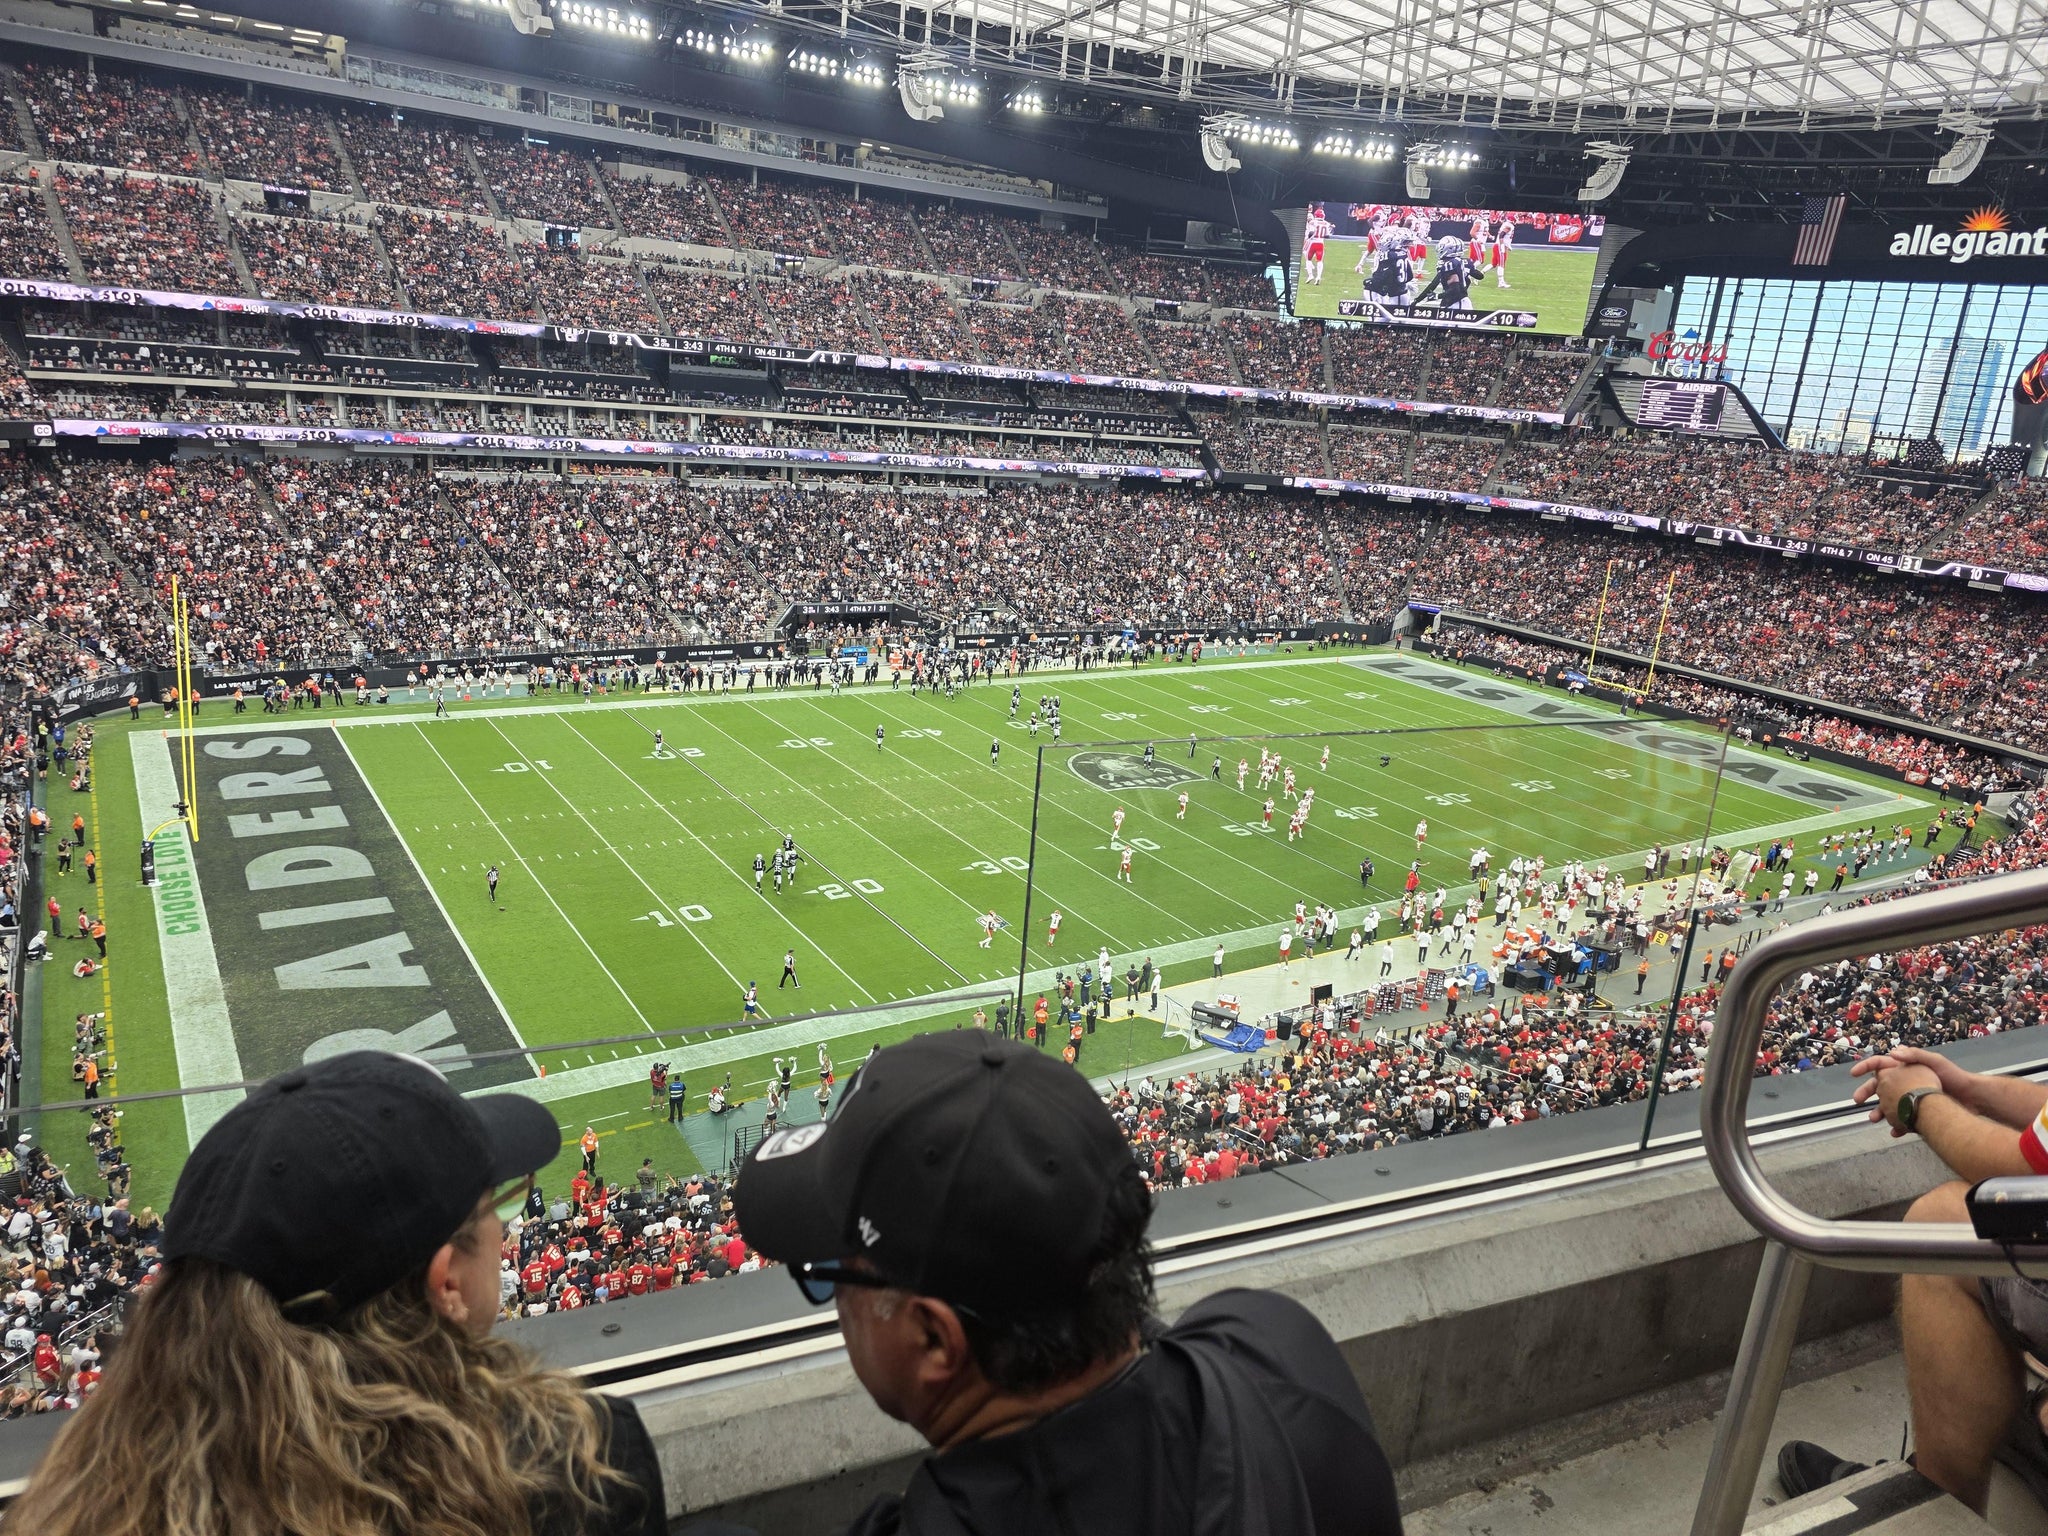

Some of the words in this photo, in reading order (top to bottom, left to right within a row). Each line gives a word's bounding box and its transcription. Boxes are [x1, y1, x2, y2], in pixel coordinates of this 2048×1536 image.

[1889, 225, 2048, 264] allegiant
[0, 282, 39, 296] OLD
[103, 290, 143, 304] STOP
[243, 305, 270, 314] LIGHT
[302, 307, 340, 319] COLD
[391, 315, 425, 326] STOP
[1361, 304, 1374, 316] 13
[1413, 309, 1432, 318] 3:43
[1604, 307, 1622, 317] Ford
[1500, 314, 1513, 325] 10
[500, 326, 522, 335] LIGHT
[683, 341, 703, 351] 3:43
[715, 345, 731, 353] 4TH
[767, 349, 777, 357] 45
[786, 350, 795, 358] 31
[1647, 330, 1729, 363] Coors
[1651, 360, 1716, 380] LIGHT
[1676, 382, 1717, 393] RAIDERS
[140, 427, 169, 437] LIGHT
[204, 426, 245, 438] COLD
[302, 430, 337, 440] STOP
[419, 436, 442, 445] LIGHT
[474, 436, 505, 448] COLD
[552, 440, 582, 450] STOP
[699, 446, 725, 456] COLD
[764, 449, 790, 459] STOP
[1055, 464, 1078, 473] COLD
[1108, 466, 1129, 475] STOP
[1366, 485, 1391, 494] COLD
[1428, 490, 1452, 500] STOP
[1549, 505, 1575, 517] COLD
[1608, 512, 1634, 525] STOP
[1785, 540, 1808, 551] 3:43
[1820, 547, 1839, 556] 4TH
[1866, 553, 1881, 562] ON
[1881, 554, 1893, 564] 45
[1902, 557, 1921, 569] 31
[1970, 568, 1982, 580] 10
[1367, 661, 1524, 701] LAS
[783, 736, 834, 749] 30
[1527, 702, 1868, 803] VEGAS
[502, 759, 554, 773] 10
[1511, 779, 1556, 793] 20
[1425, 793, 1472, 806] 30
[1334, 806, 1379, 820] 40
[1221, 821, 1277, 837] 50
[153, 830, 188, 868] LOVE
[971, 856, 1030, 875] 30
[817, 878, 885, 901] 20
[158, 870, 200, 936] CHOOSE
[204, 736, 473, 1073] RAIDERS
[648, 904, 713, 928] 10
[591, 1208, 601, 1218] 15
[531, 1272, 542, 1283] 15
[631, 1274, 644, 1285] 87
[609, 1281, 620, 1291] 15
